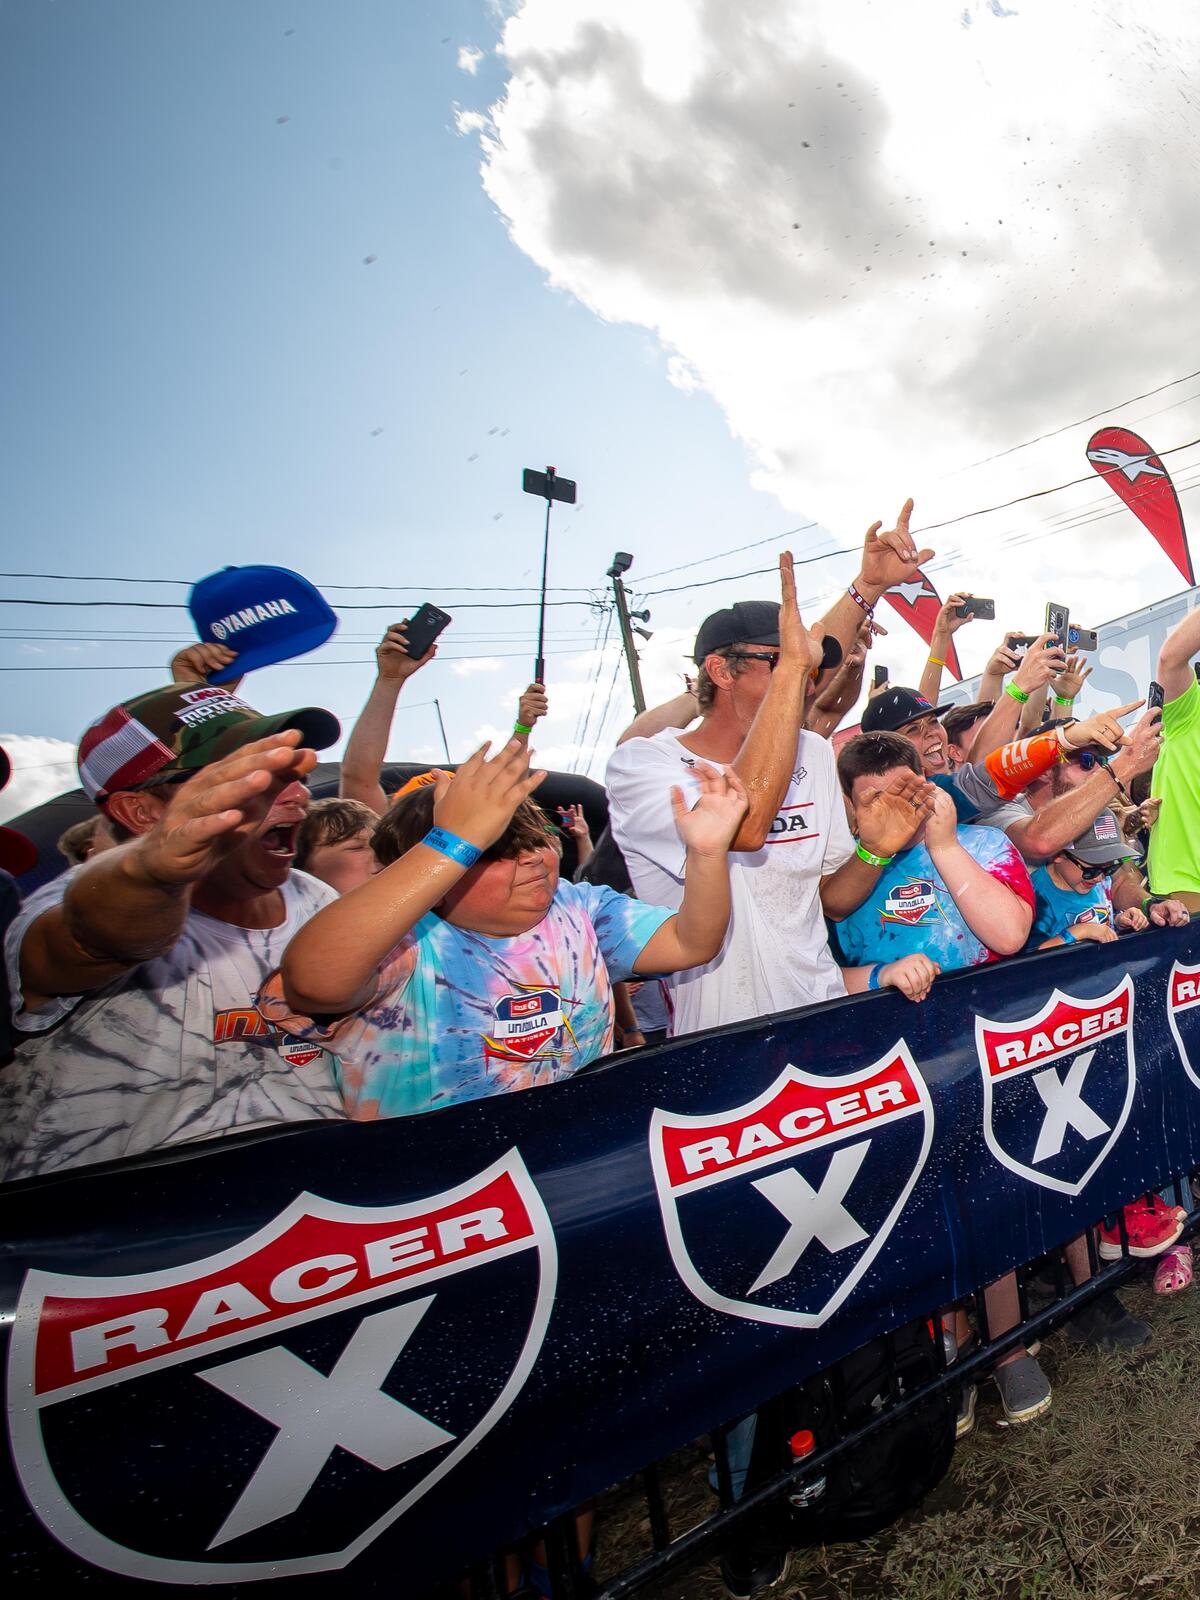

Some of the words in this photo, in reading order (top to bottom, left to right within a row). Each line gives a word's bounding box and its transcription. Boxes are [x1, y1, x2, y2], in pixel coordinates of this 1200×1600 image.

[220, 598, 298, 633] YAMAHA
[508, 1030, 551, 1044] NATIONAL
[994, 1006, 1124, 1068] RACER
[679, 1080, 908, 1175] RACER
[1031, 1048, 1112, 1165] X
[745, 1138, 873, 1298] X
[70, 1206, 510, 1373] RACER
[194, 1293, 458, 1551] X
